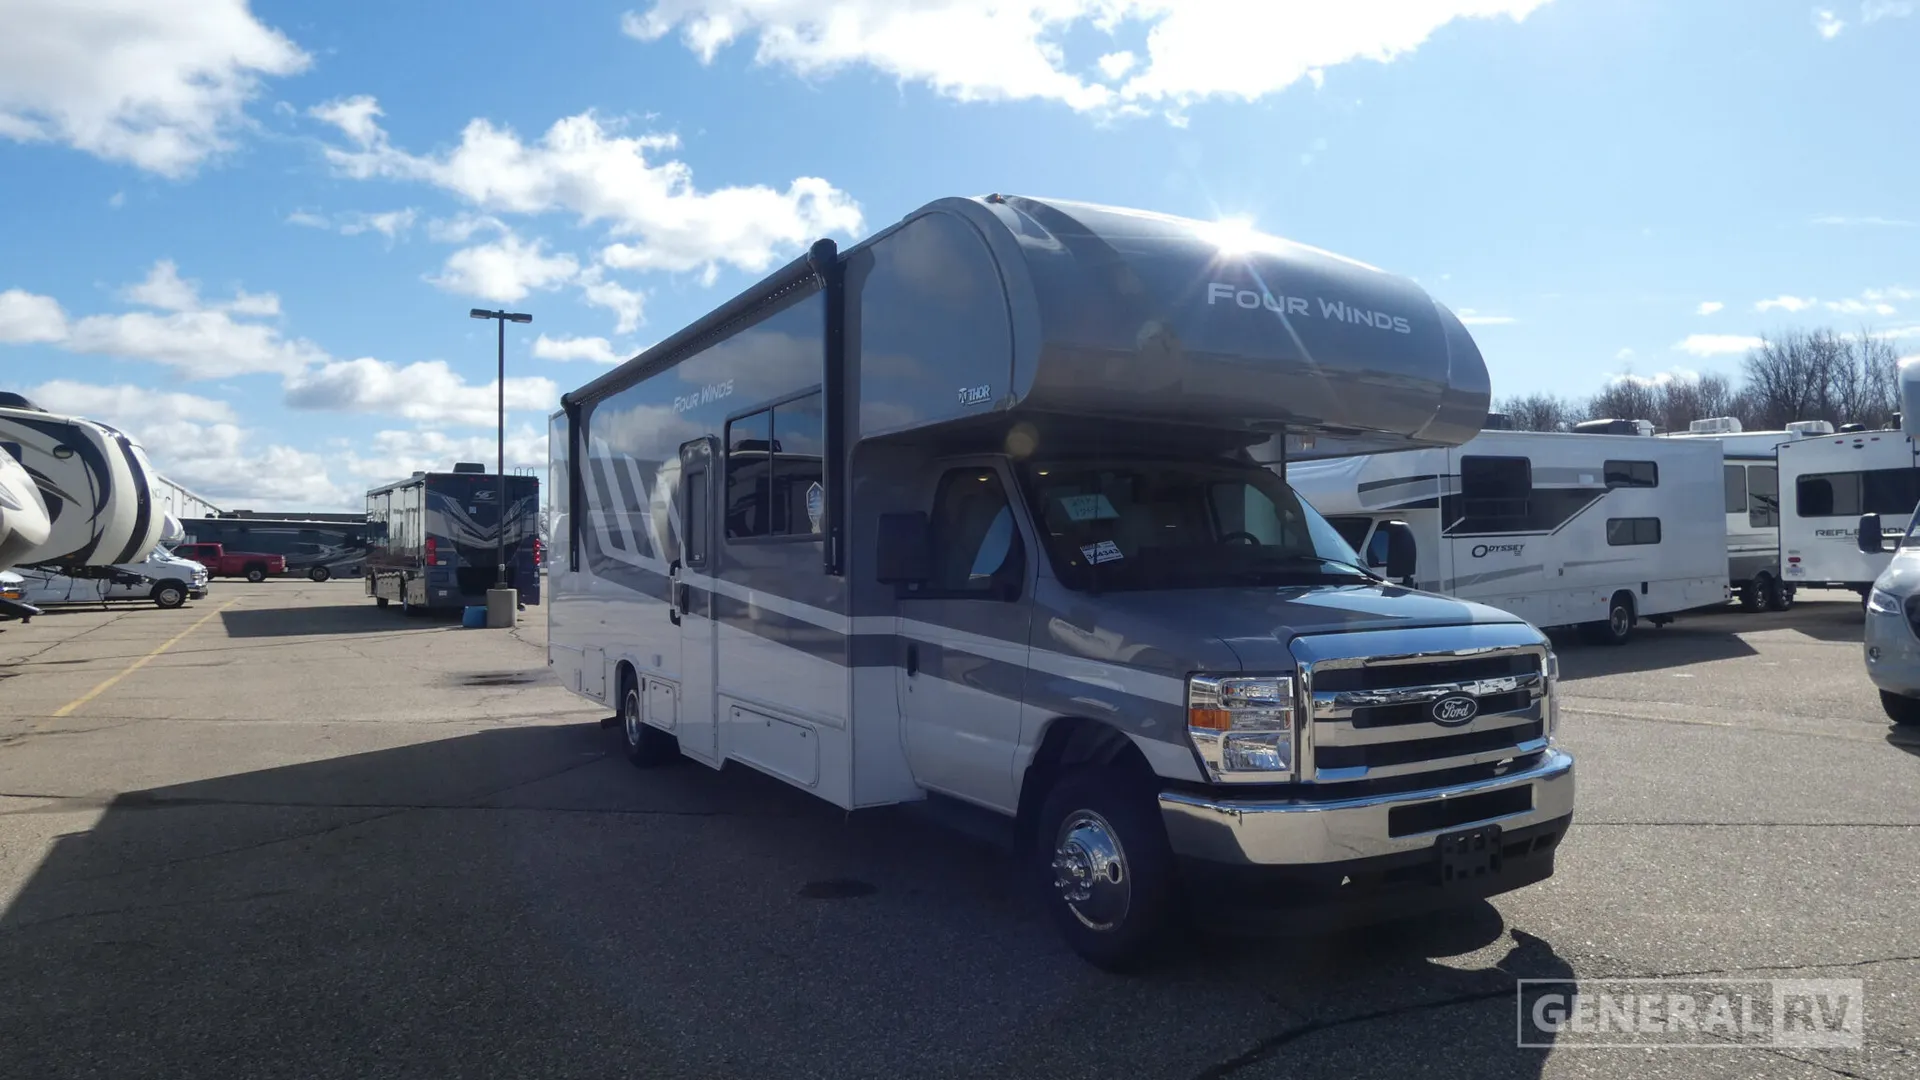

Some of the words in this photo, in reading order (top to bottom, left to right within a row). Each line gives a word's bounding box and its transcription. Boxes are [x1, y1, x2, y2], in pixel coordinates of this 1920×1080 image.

[1207, 282, 1310, 317] FOUR
[1317, 297, 1411, 334] WINDS
[672, 392, 700, 414] FOUR
[701, 379, 734, 406] WINDS
[967, 384, 992, 401] THOR
[1815, 527, 1907, 537] REFLEION
[1471, 544, 1525, 558] ODYSSEY
[1441, 700, 1470, 719] Ford
